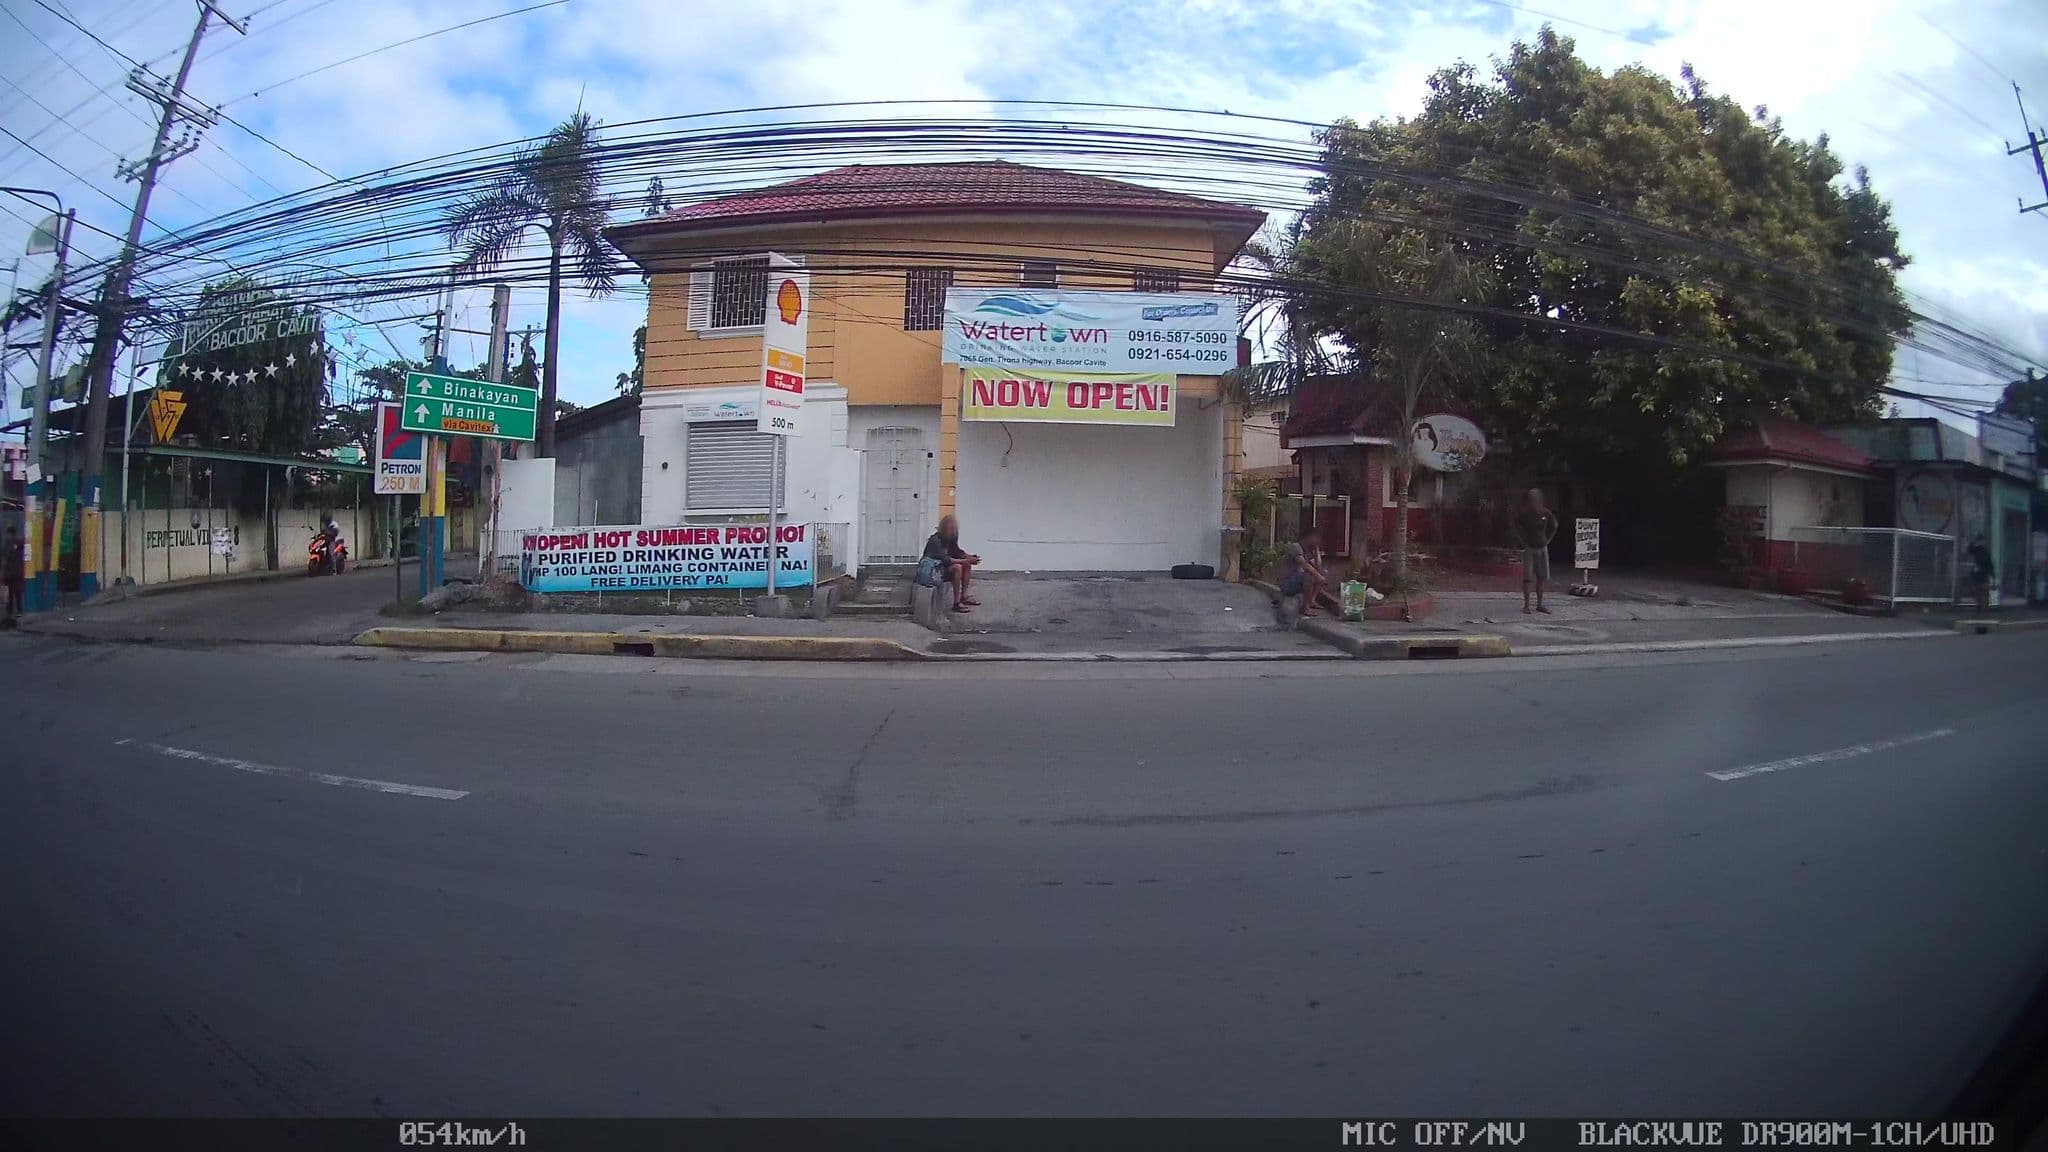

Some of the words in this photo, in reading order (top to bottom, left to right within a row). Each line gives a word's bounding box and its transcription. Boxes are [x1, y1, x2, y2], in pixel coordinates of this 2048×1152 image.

[210, 323, 267, 351] BACOOR
[1128, 330, 1227, 344] 0916-587-5090
[1128, 347, 1228, 362] 0921-654-0296
[1056, 358, 1082, 366] Bacoor
[1083, 358, 1107, 367] Cavite
[444, 382, 519, 404] Binakayan
[972, 379, 1053, 408] NOW
[1067, 382, 1169, 412] OPEN!
[442, 402, 495, 421] Manila
[443, 420, 457, 429] via
[459, 421, 491, 432] Cavitex
[771, 417, 786, 429] 500
[787, 421, 794, 430] m
[381, 462, 422, 474] PETRON
[382, 476, 405, 491] 250
[409, 477, 420, 490] M
[594, 531, 632, 549] HOT
[636, 528, 720, 548] SUMMER
[539, 551, 617, 565] PURIFIED
[623, 547, 714, 563] DRINKING
[554, 566, 577, 577] 100
[582, 565, 622, 576] LANG!
[627, 563, 683, 575] LIMANG
[781, 560, 807, 571] NA!
[591, 577, 626, 587] FREE
[631, 575, 701, 587] DELIVERY
[705, 574, 729, 585] PA!
